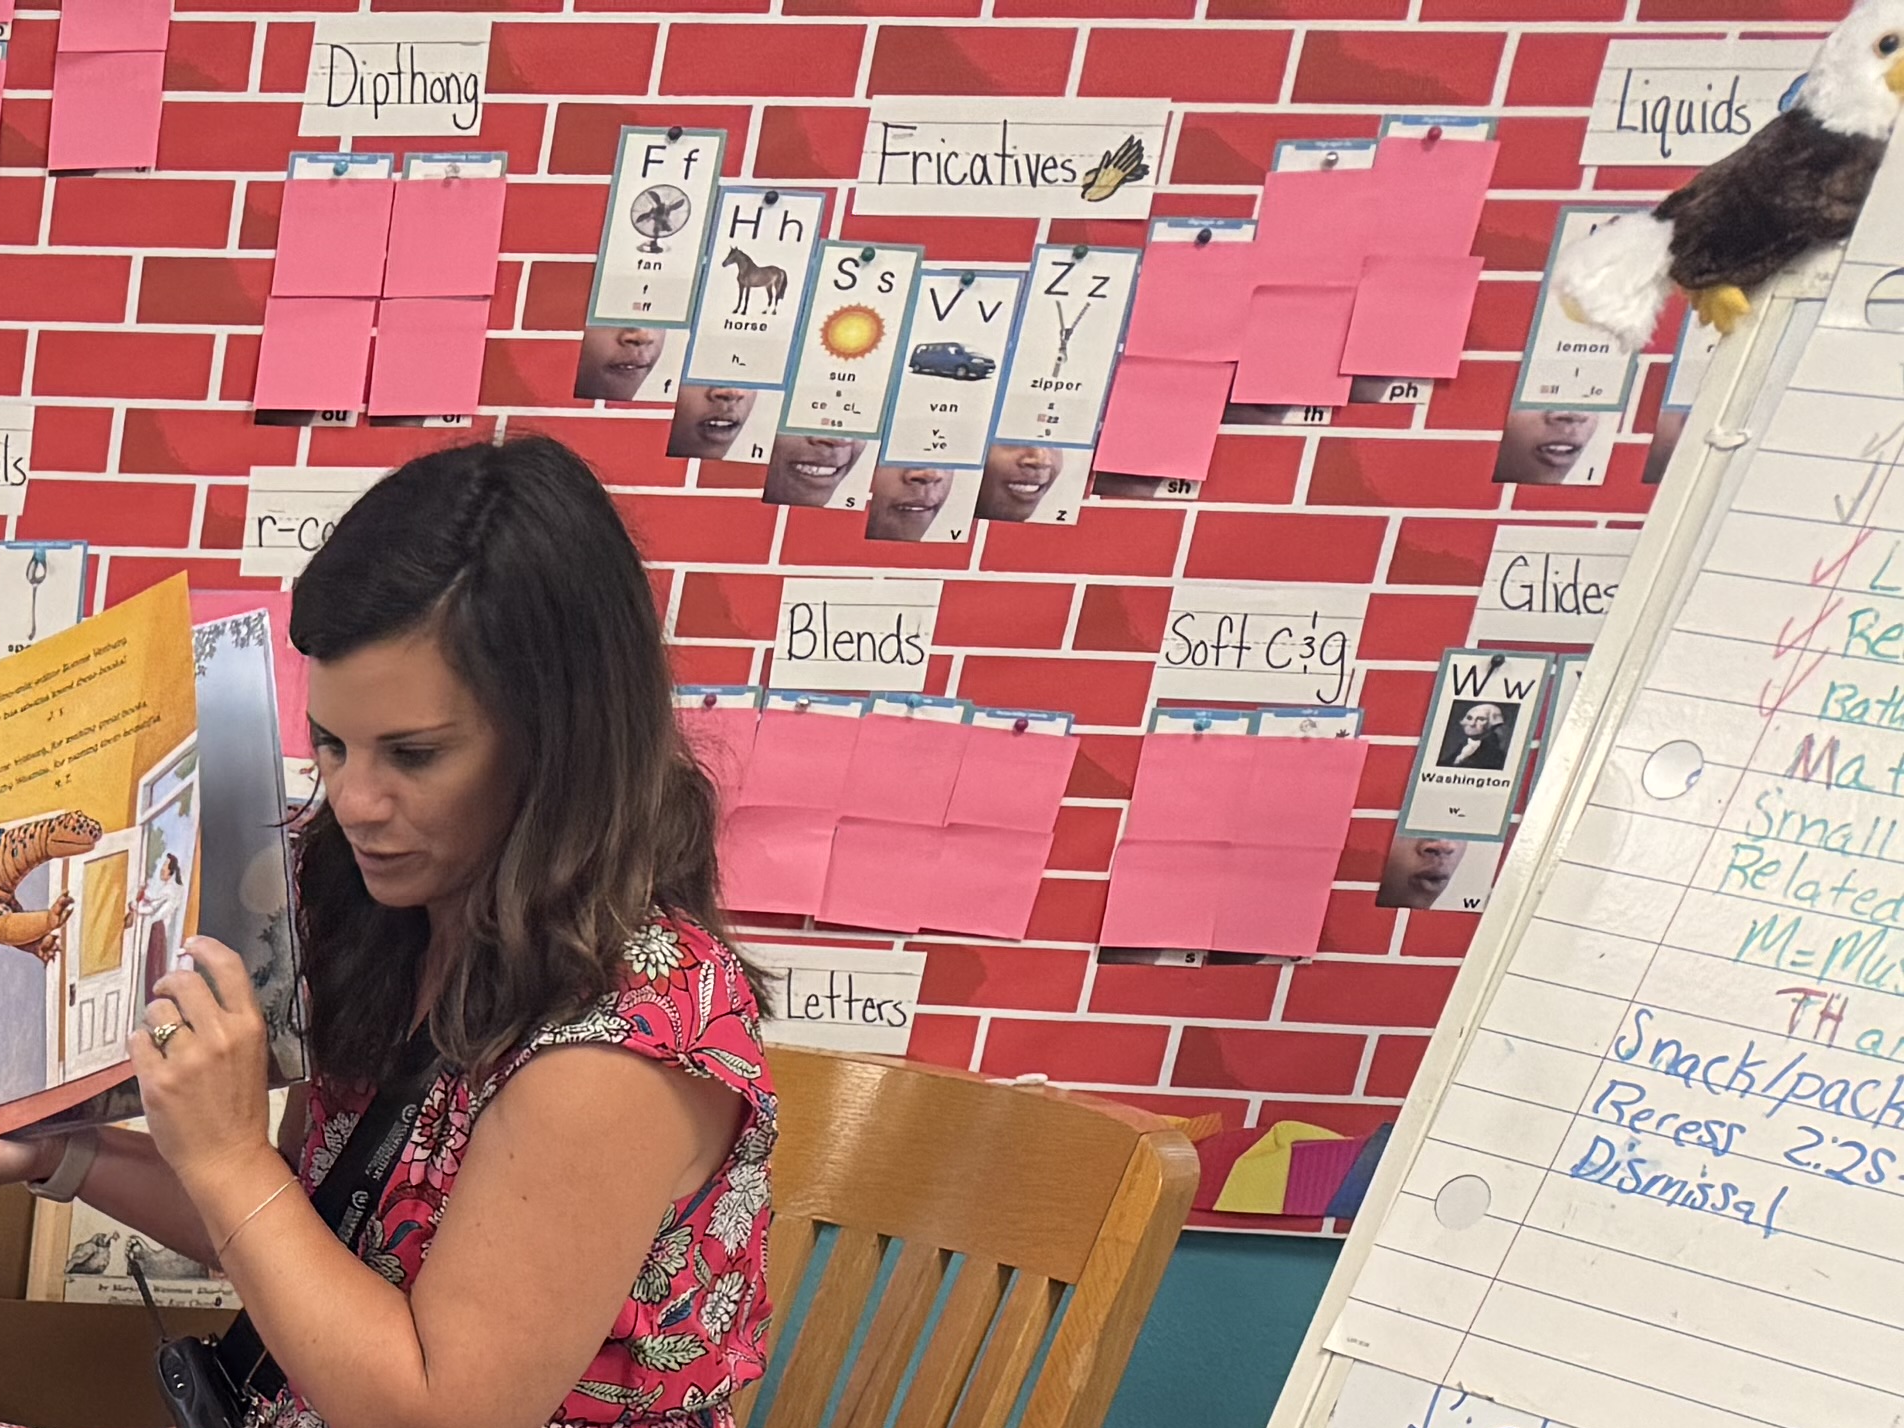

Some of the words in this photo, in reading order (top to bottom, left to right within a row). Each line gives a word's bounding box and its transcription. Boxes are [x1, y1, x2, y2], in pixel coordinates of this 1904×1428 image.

[327, 43, 479, 130] Dipthong
[1616, 68, 1752, 158] Liquids
[641, 145, 668, 178] F
[683, 148, 700, 178] f
[879, 119, 1077, 188] Fricatives
[729, 205, 761, 240] H
[779, 210, 804, 242] h
[637, 258, 662, 271] fan
[833, 257, 859, 290] S
[877, 271, 896, 294] s
[1044, 261, 1075, 296] Z
[1087, 275, 1110, 298] z
[929, 288, 964, 322] V
[978, 300, 1002, 323] v
[723, 319, 768, 332] horse
[1556, 341, 1610, 354] lemon
[663, 378, 672, 394] f
[829, 371, 856, 381] sun
[1030, 377, 1083, 393] zipper
[1389, 381, 1419, 402] ph
[929, 402, 958, 413] van
[751, 443, 763, 458] h
[1167, 478, 1191, 494] sh
[846, 497, 855, 508] s
[1056, 510, 1067, 522] z
[950, 529, 962, 541] v
[787, 601, 926, 666] Blends
[1164, 613, 1253, 669] Soft
[1316, 629, 1348, 704] g
[1451, 661, 1497, 698] W
[1503, 678, 1536, 700] w
[1421, 772, 1511, 789] Washington
[1746, 787, 1897, 856] Small
[1463, 897, 1481, 909] w
[786, 969, 909, 1028] Letters
[1570, 1134, 1789, 1239] Dismissal
